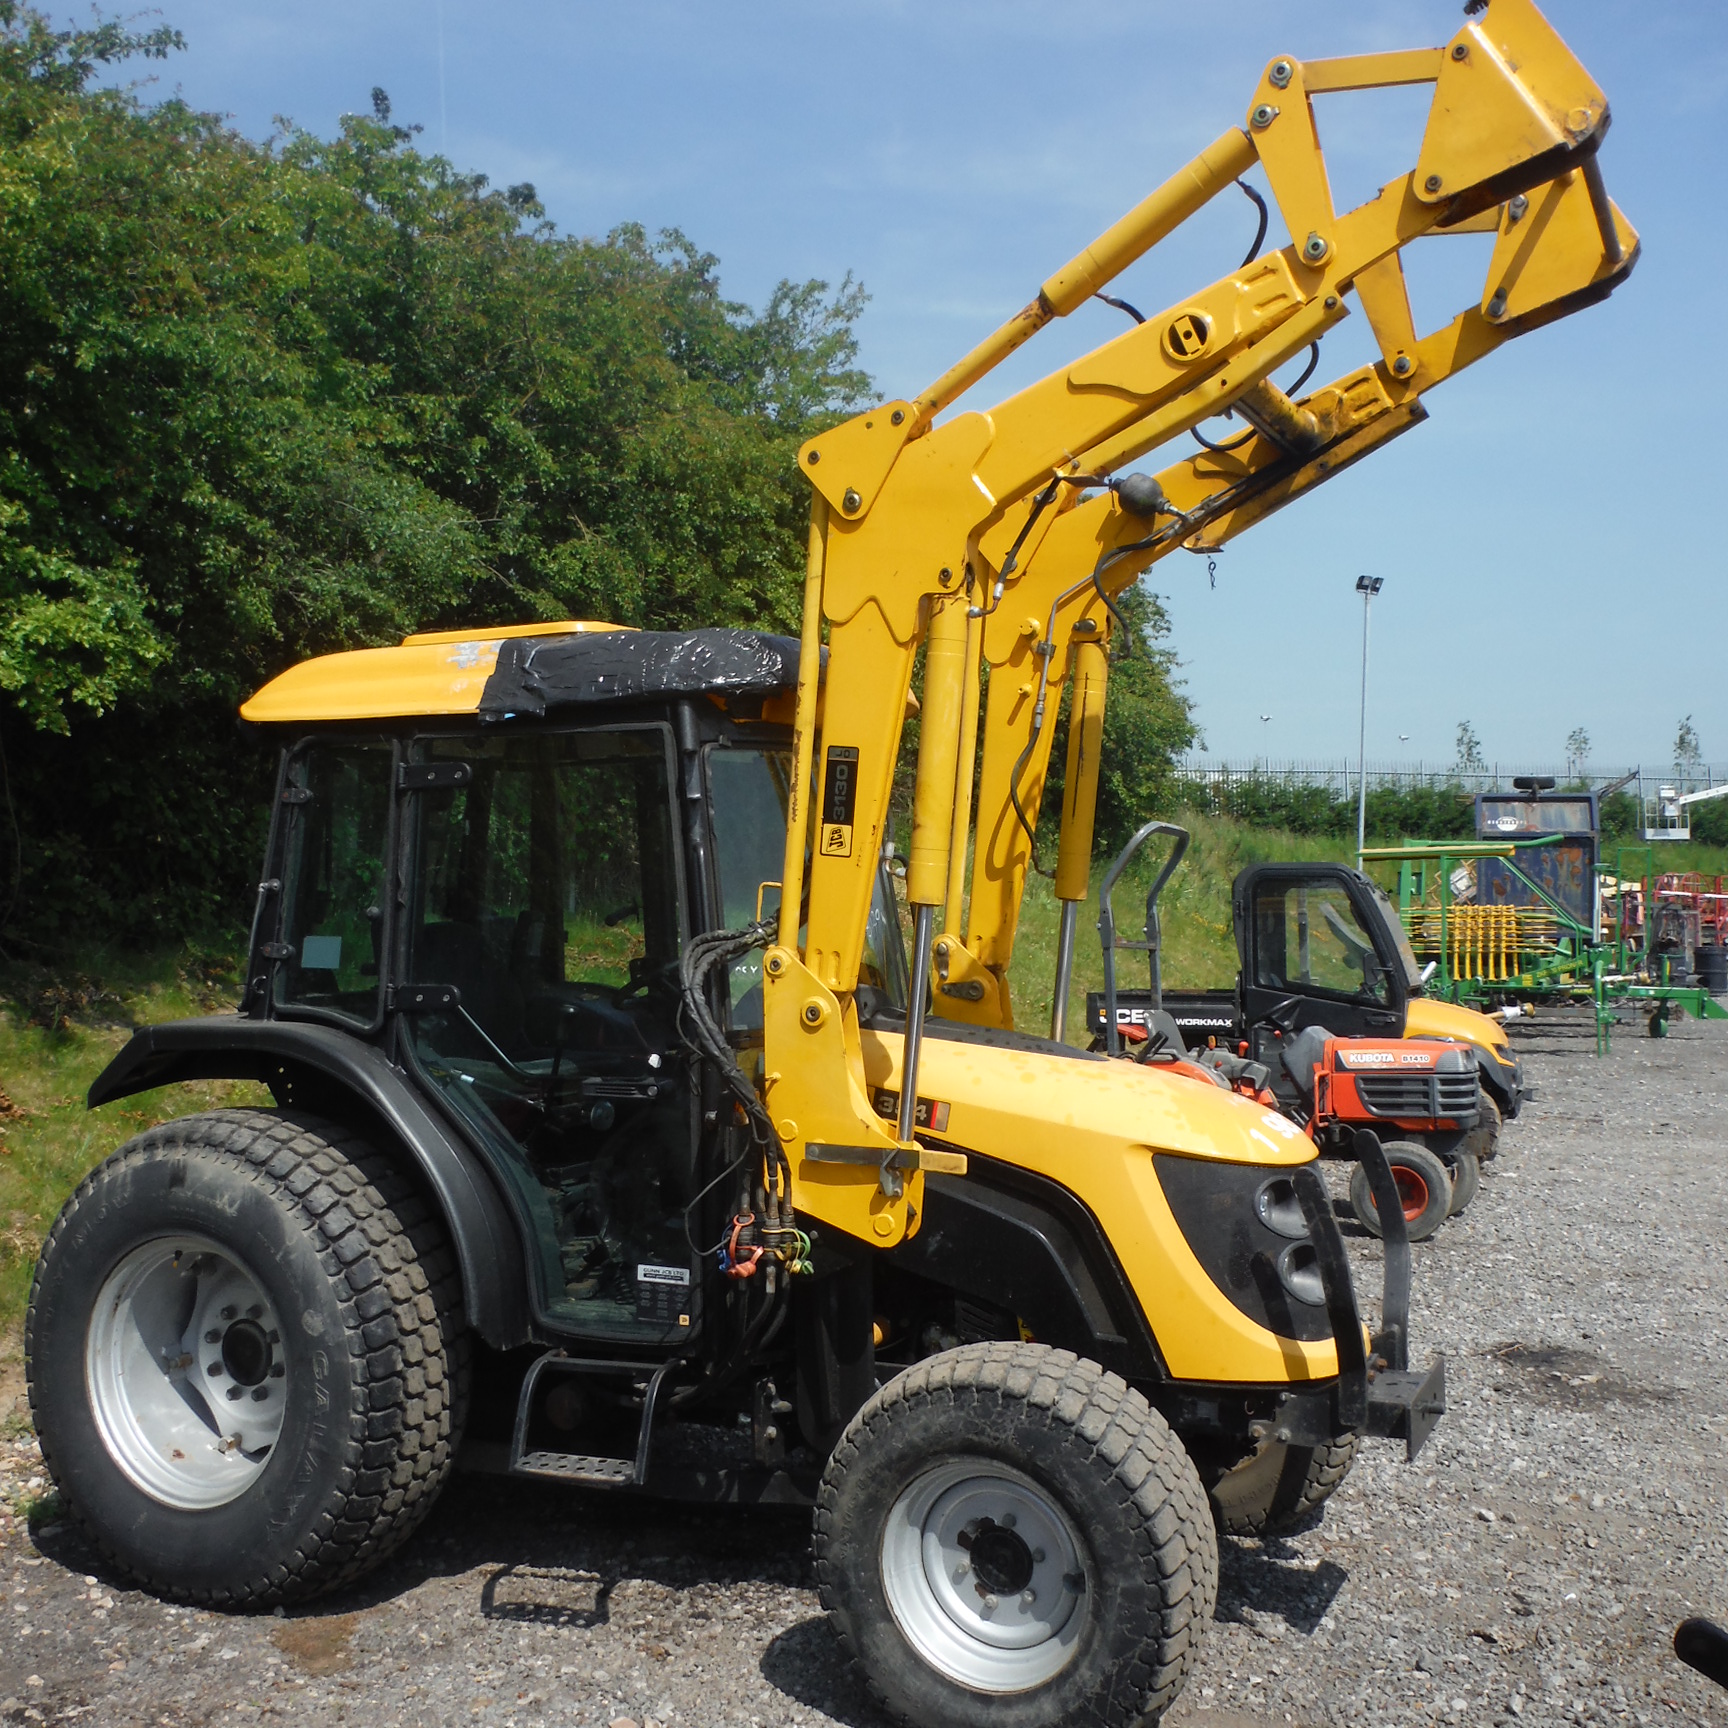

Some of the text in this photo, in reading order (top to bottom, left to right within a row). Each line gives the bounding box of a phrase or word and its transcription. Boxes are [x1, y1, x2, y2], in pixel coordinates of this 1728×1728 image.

[833, 764, 849, 821] 3130
[828, 827, 844, 848] JCB
[1174, 1017, 1233, 1028] WORKMAX
[1349, 1052, 1431, 1064] KUBOTA B1410
[877, 1095, 928, 1122] 34
